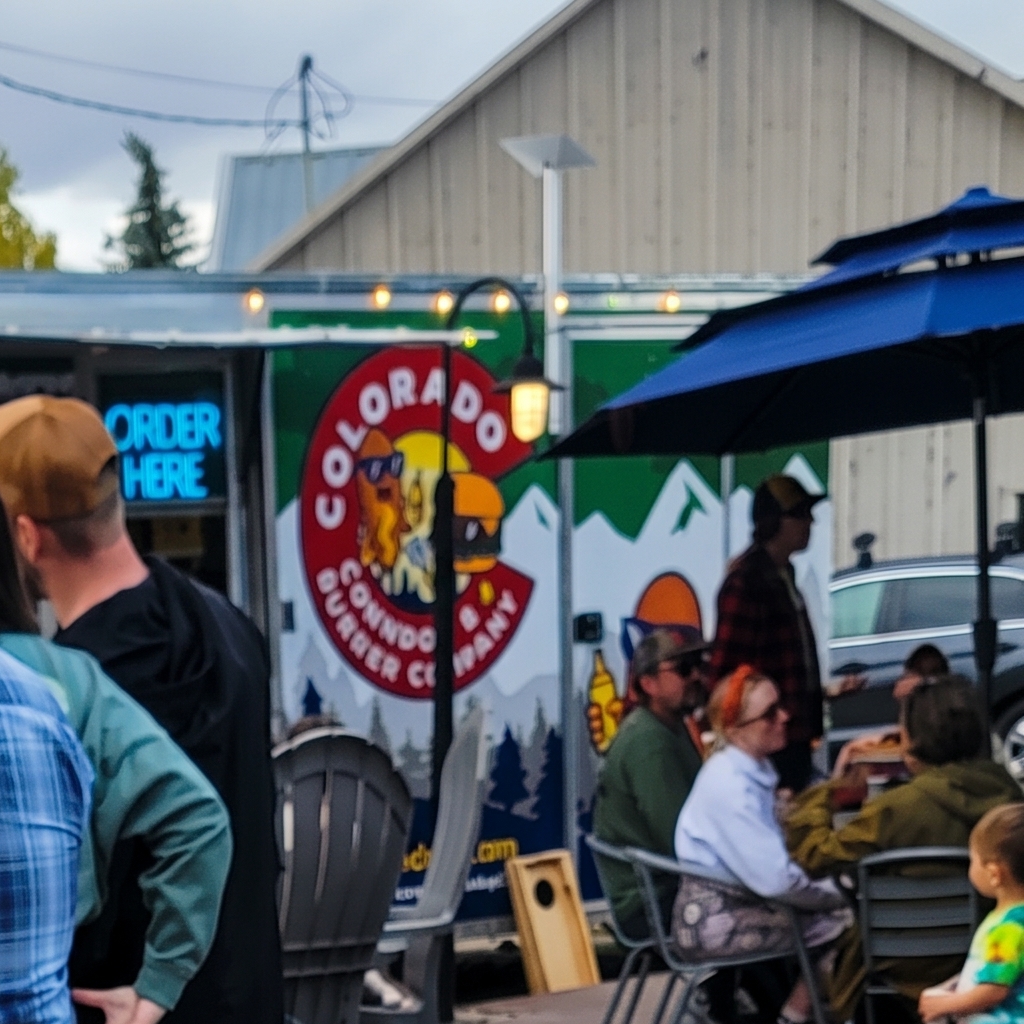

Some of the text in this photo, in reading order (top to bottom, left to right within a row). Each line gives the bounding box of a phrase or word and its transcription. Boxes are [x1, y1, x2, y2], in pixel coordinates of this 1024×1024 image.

[105, 402, 221, 452] ORDER
[315, 366, 507, 530] COLORADO
[123, 452, 209, 499] HERE
